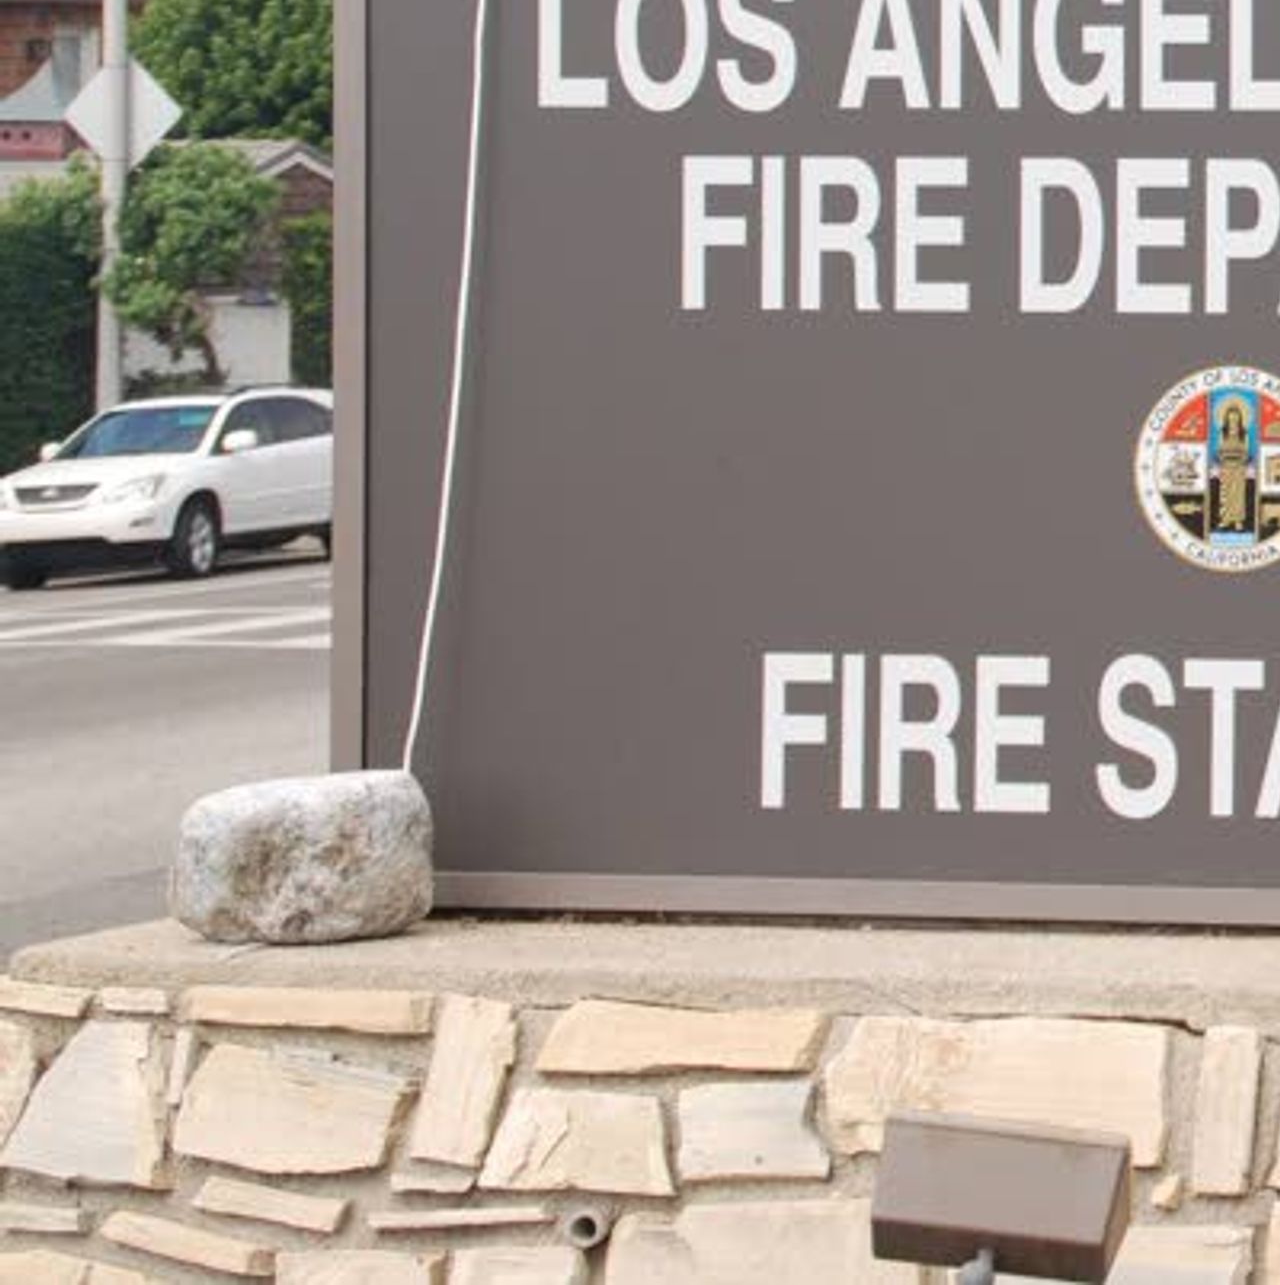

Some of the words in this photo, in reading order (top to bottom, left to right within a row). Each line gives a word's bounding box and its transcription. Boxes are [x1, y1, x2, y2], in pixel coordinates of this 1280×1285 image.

[683, 157, 969, 312] FIRE
[1150, 382, 1199, 432] COUNTY
[1202, 370, 1222, 387] OF
[1230, 370, 1259, 387] LOS
[1186, 541, 1280, 567] CALIFORNIA
[762, 654, 1050, 813] FIRE
